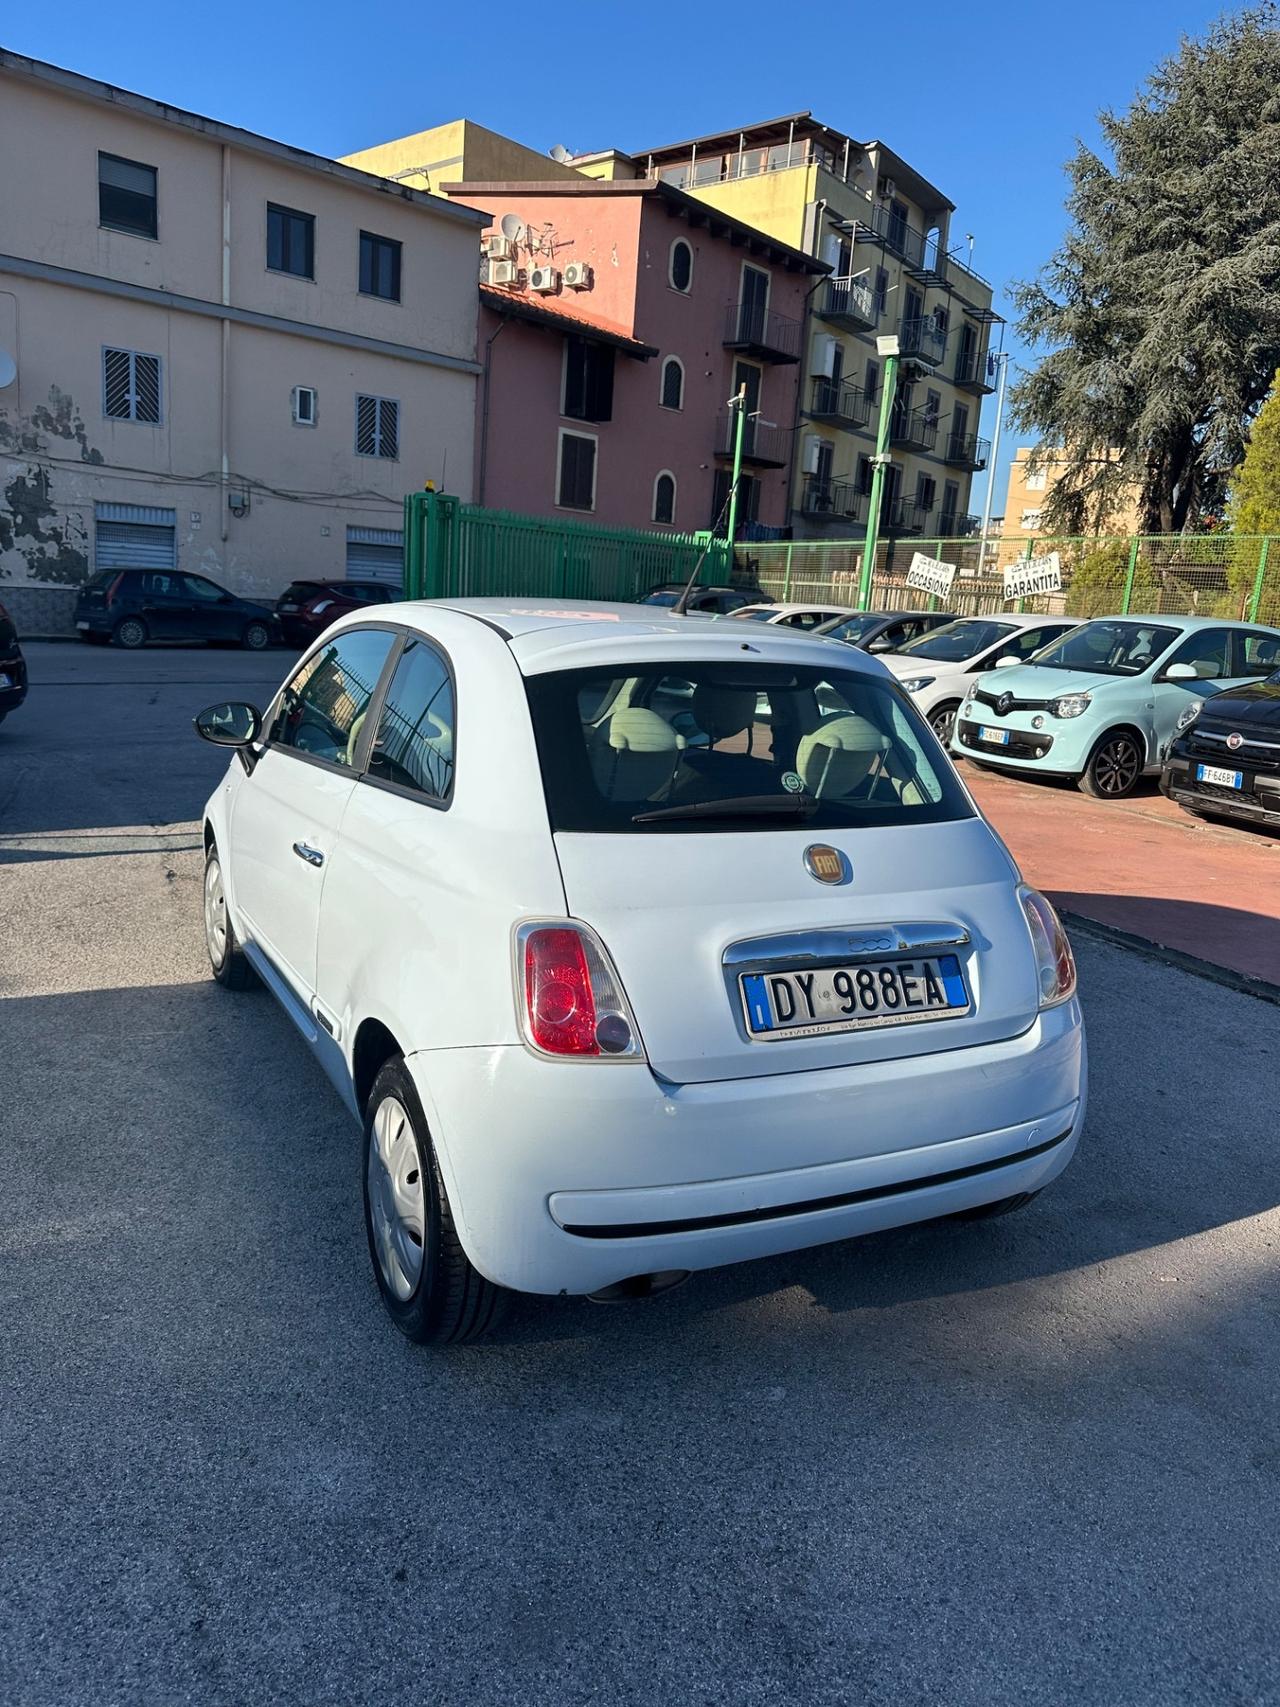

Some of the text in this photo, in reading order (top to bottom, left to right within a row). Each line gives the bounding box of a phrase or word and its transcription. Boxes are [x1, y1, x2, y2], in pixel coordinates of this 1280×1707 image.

[908, 572, 950, 597] OCCASIONE
[1005, 573, 1060, 599] GARANTITA
[814, 855, 840, 874] FIAT
[770, 973, 817, 1022] DY
[833, 962, 945, 1014] 988EA
